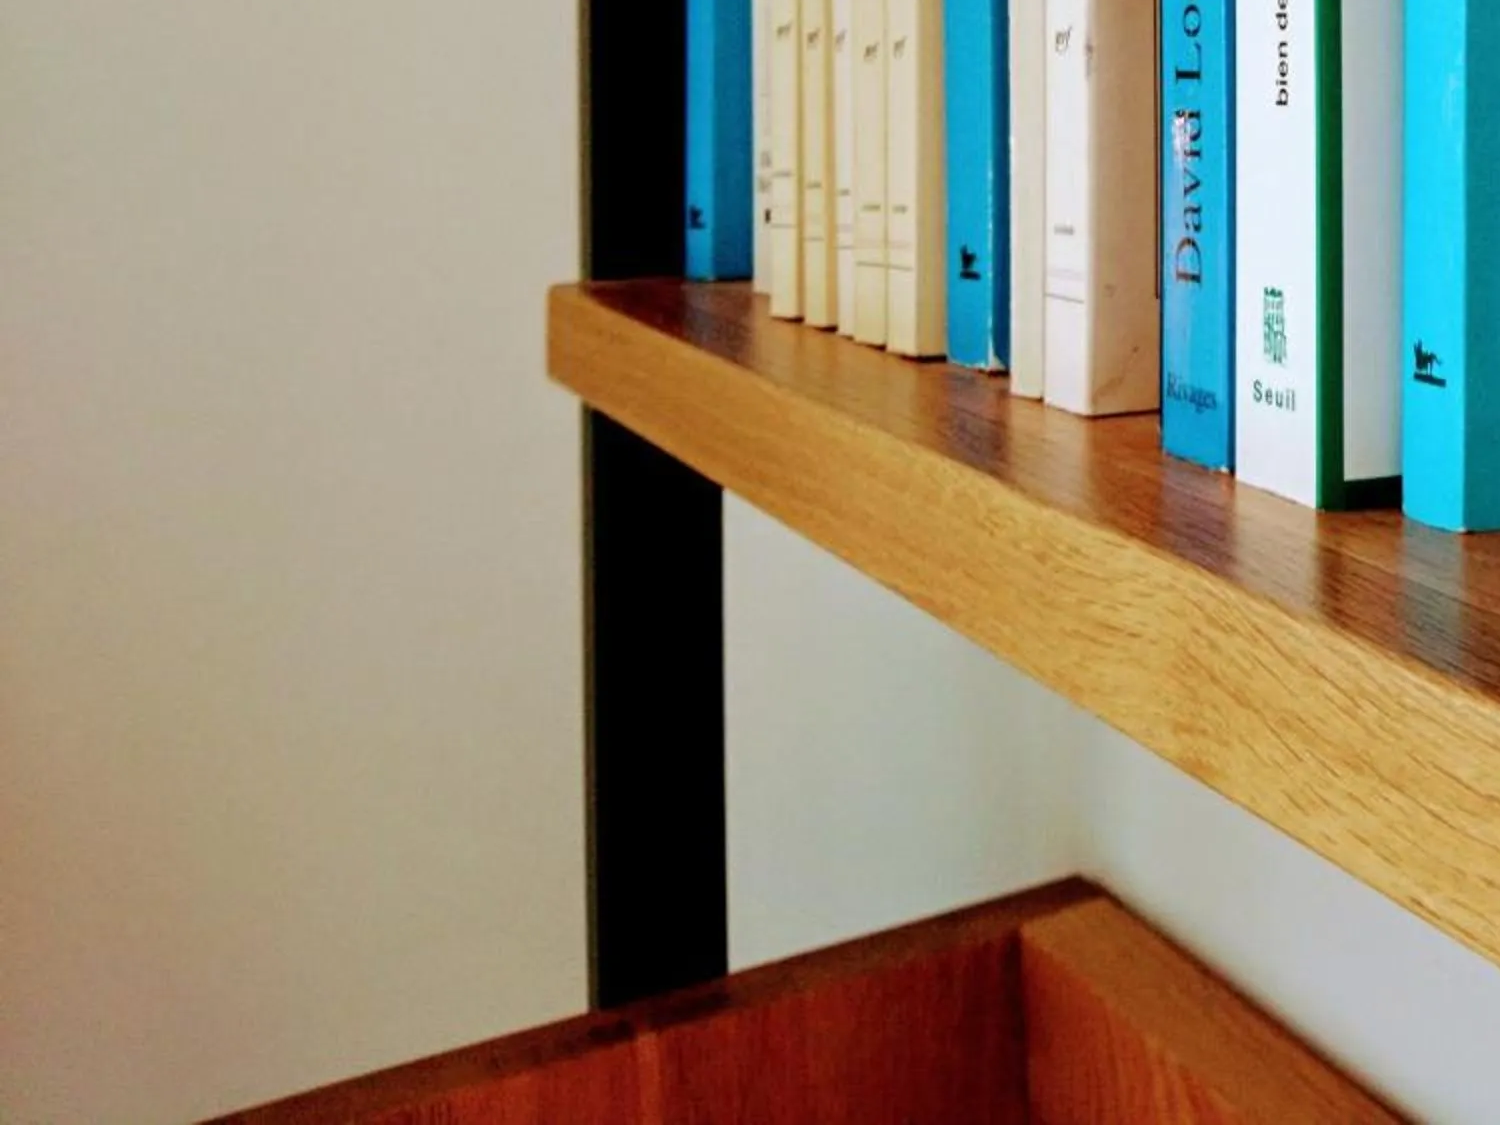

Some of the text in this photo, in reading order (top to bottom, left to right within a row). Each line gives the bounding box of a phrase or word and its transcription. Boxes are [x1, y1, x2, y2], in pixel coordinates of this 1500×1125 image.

[1275, 41, 1290, 108] bien
[1174, 109, 1204, 285] David
[1252, 378, 1296, 412] Seuil
